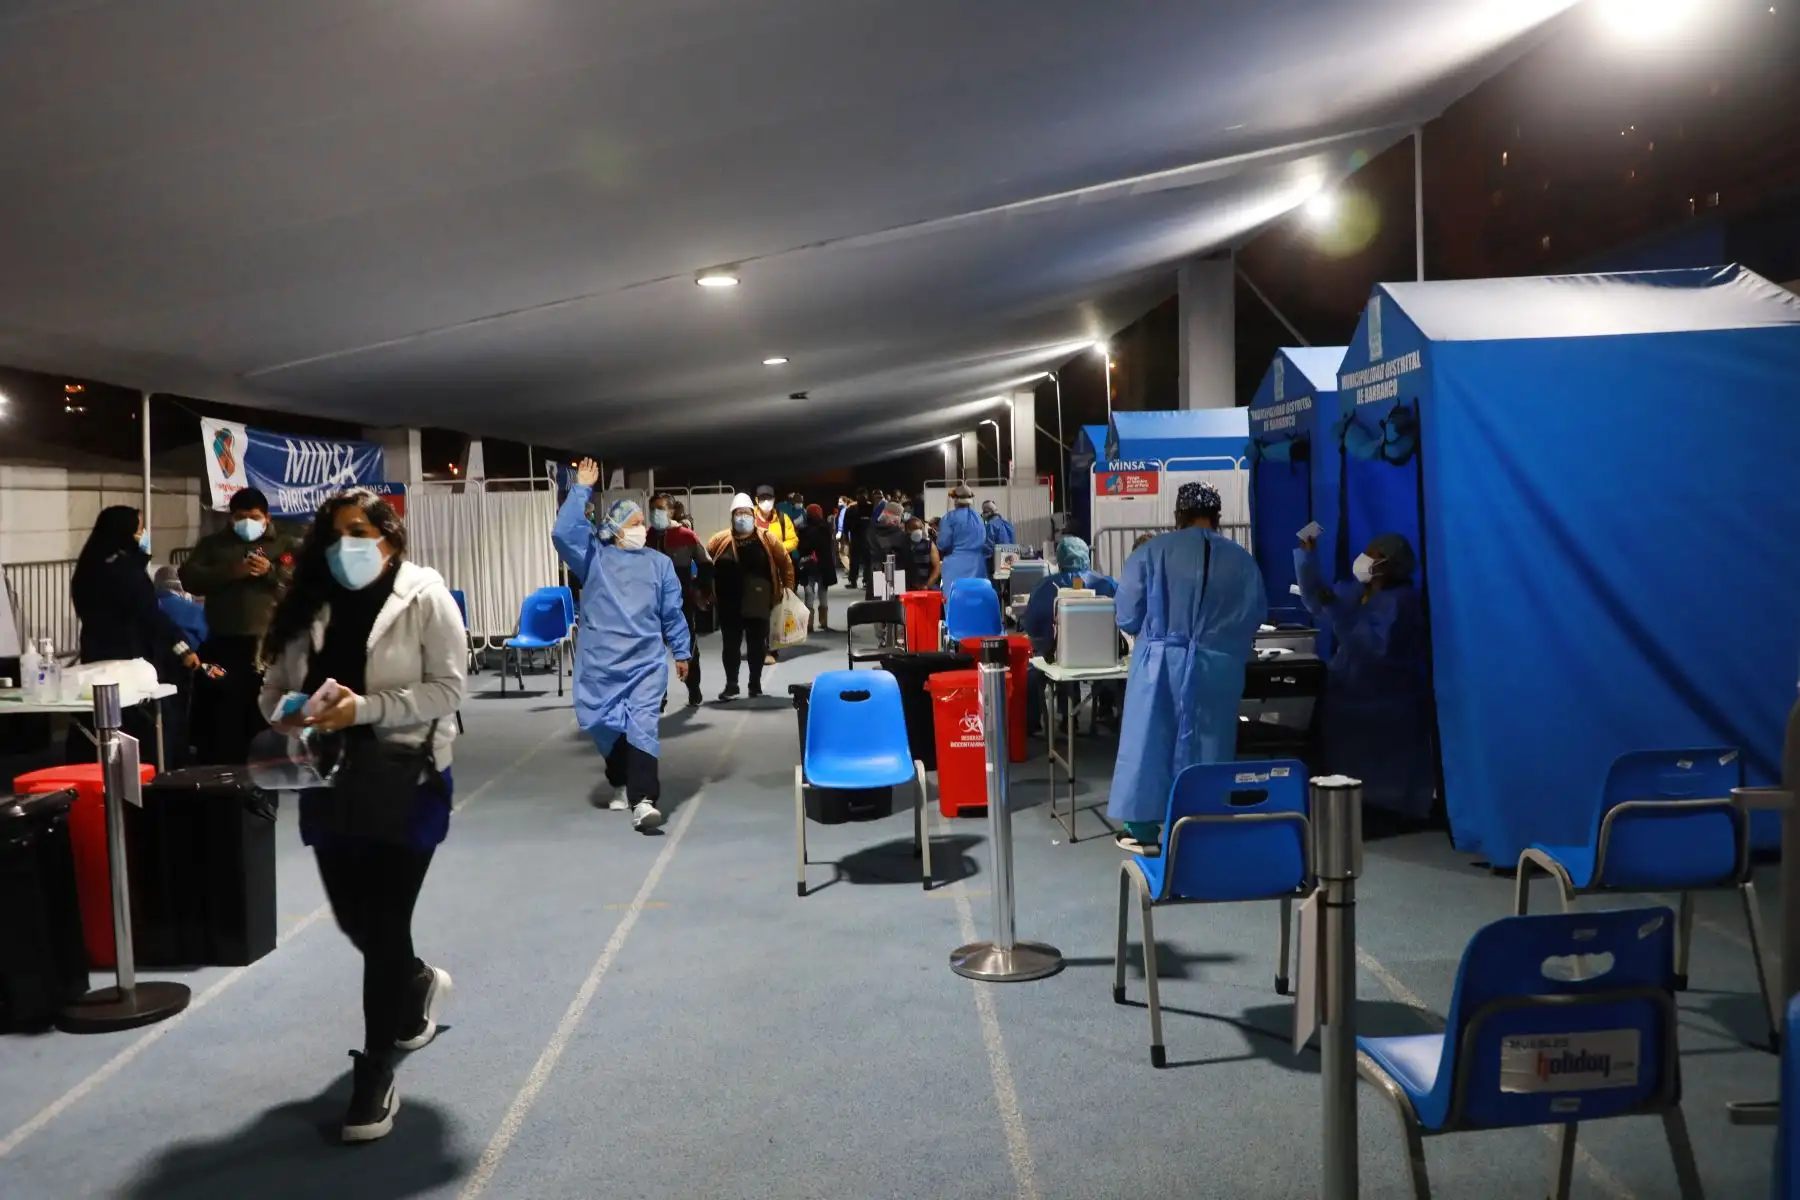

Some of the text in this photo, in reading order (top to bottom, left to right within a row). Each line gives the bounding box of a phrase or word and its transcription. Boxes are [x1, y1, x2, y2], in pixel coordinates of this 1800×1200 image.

[1385, 350, 1421, 377] DISTRITAL
[1356, 379, 1398, 405] DE BARRANCO
[284, 440, 357, 484] MINSA
[1109, 461, 1146, 471] MINSA
[279, 489, 310, 512] DIRIS
[1538, 1049, 1610, 1082] holiday
